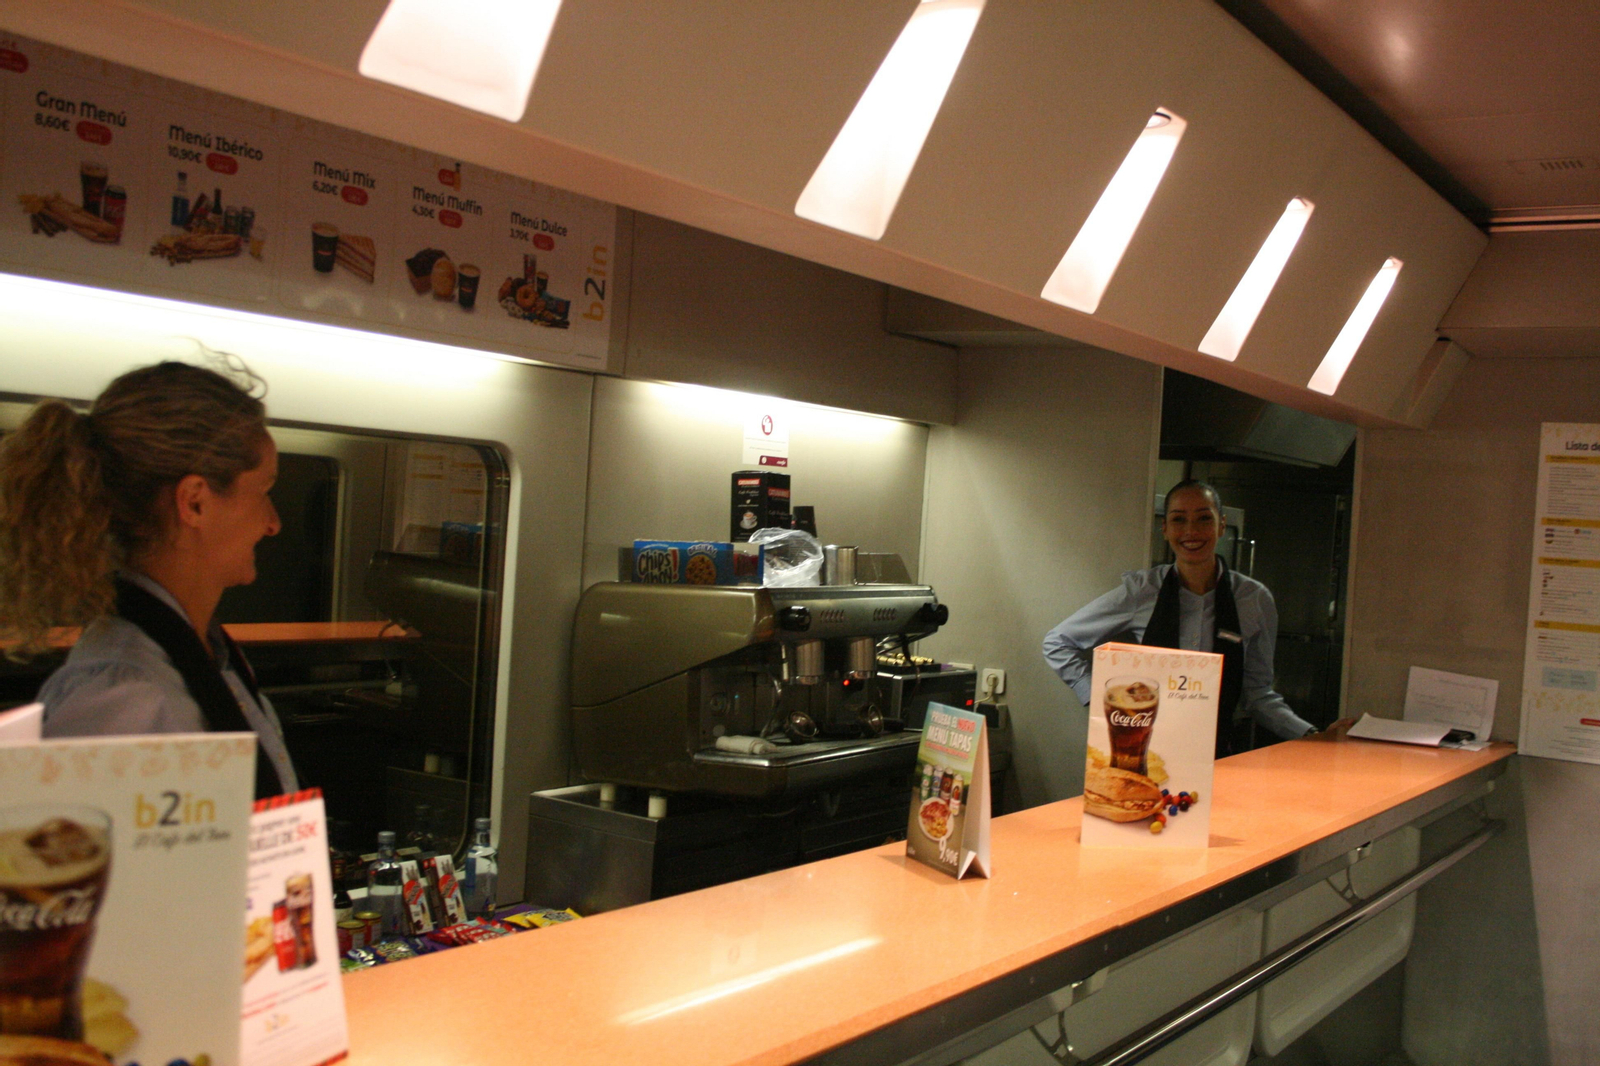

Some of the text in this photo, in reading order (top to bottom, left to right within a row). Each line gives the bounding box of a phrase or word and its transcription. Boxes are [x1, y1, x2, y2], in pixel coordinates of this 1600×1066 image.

[36, 91, 127, 126] Gran Menú
[35, 113, 70, 131] 8,60€
[169, 145, 202, 163] 10,90€
[170, 125, 264, 161] Menú Ibérico
[313, 160, 376, 189] Menú Mix
[413, 186, 483, 216] Menú Muffin
[510, 211, 567, 236] Menú Dulce
[583, 244, 608, 322] b2in
[1566, 441, 1588, 450] Lista
[638, 549, 672, 577] Chips
[1168, 675, 1202, 691] b2in
[931, 711, 951, 725] PRUEBA
[950, 732, 973, 752] TAPAS
[134, 790, 217, 830] b2in
